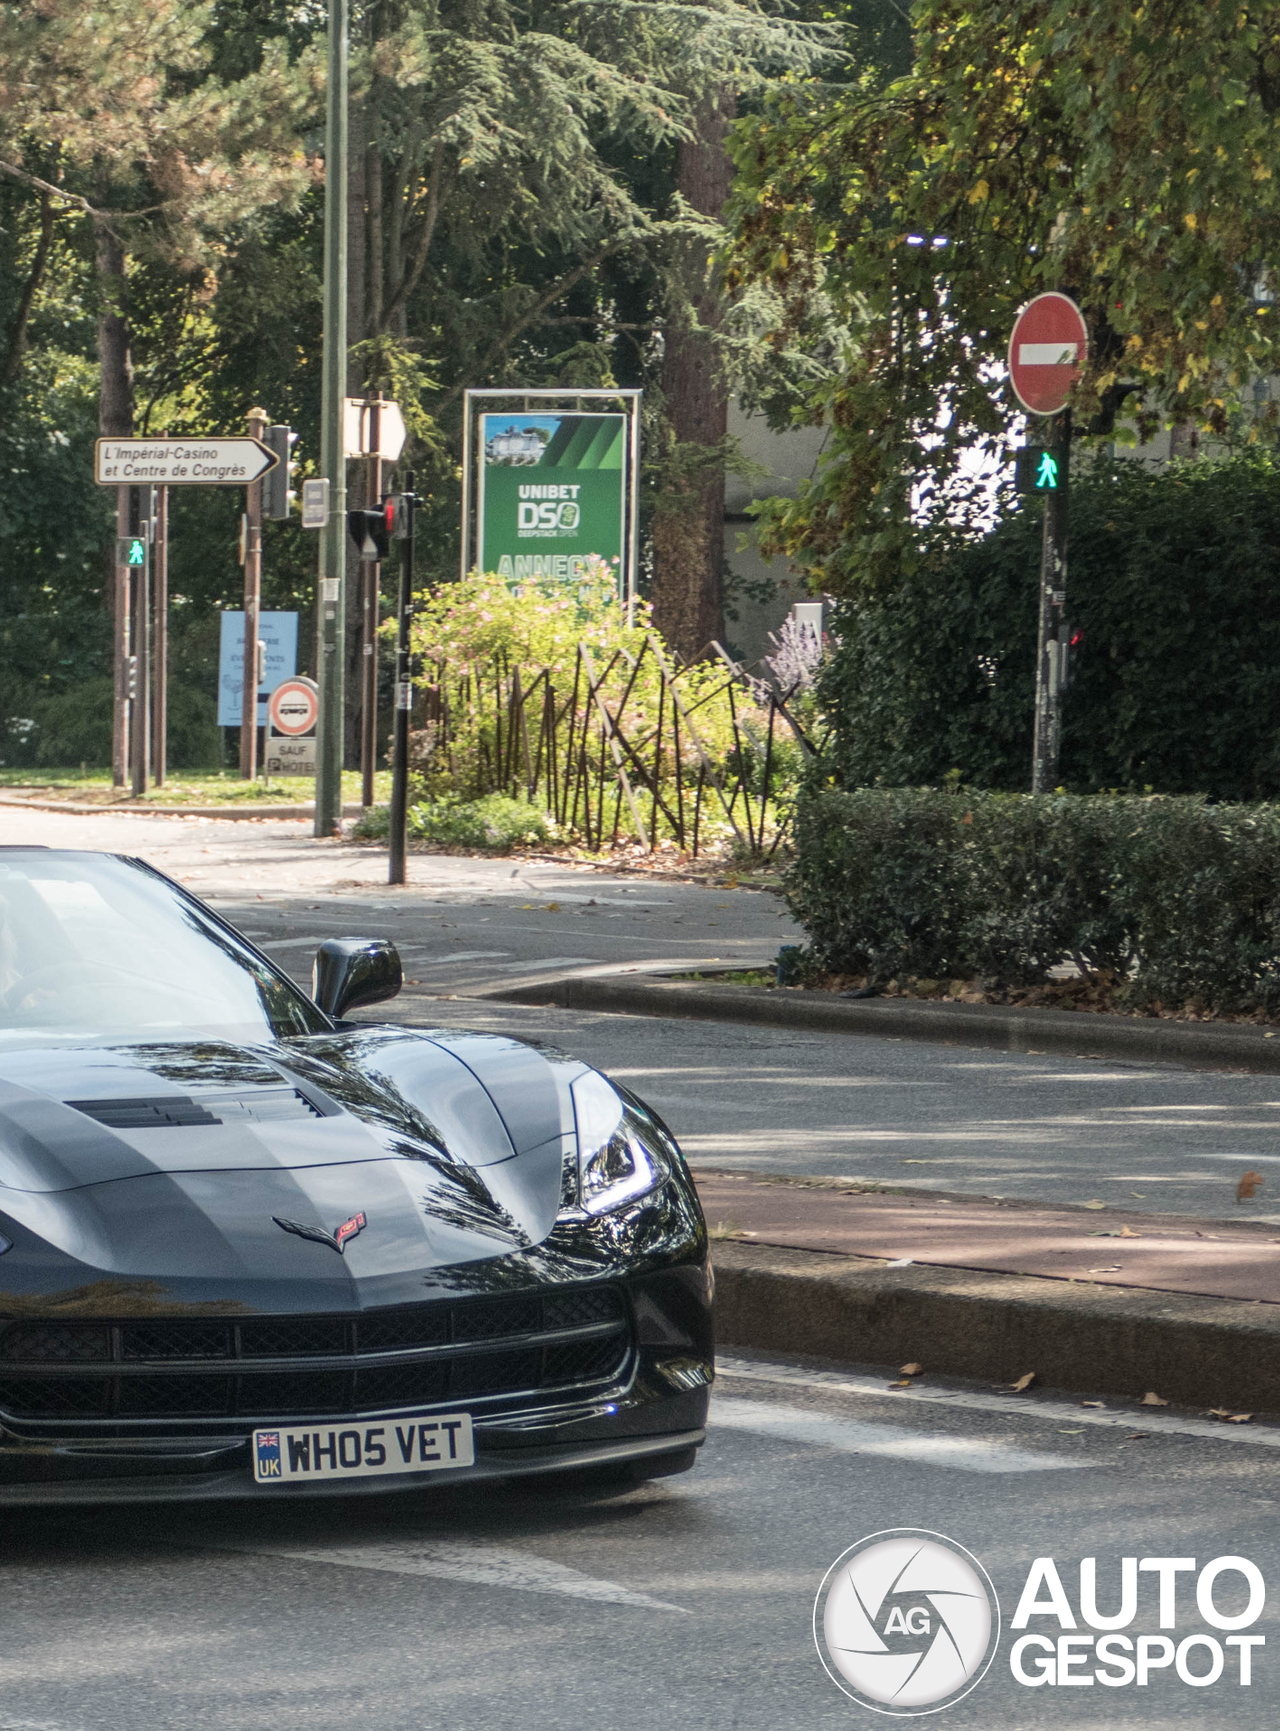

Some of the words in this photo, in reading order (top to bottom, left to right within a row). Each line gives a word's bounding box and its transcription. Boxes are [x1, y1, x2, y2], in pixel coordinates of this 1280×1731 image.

[105, 466, 118, 476] et
[123, 464, 166, 476] Centre
[171, 465, 187, 476] de
[192, 464, 246, 479] Congrès
[518, 485, 580, 499] UNIBET
[518, 502, 580, 529] DSO
[279, 745, 307, 756] SAUF
[260, 1459, 280, 1476] UK
[395, 1420, 462, 1464] VET
